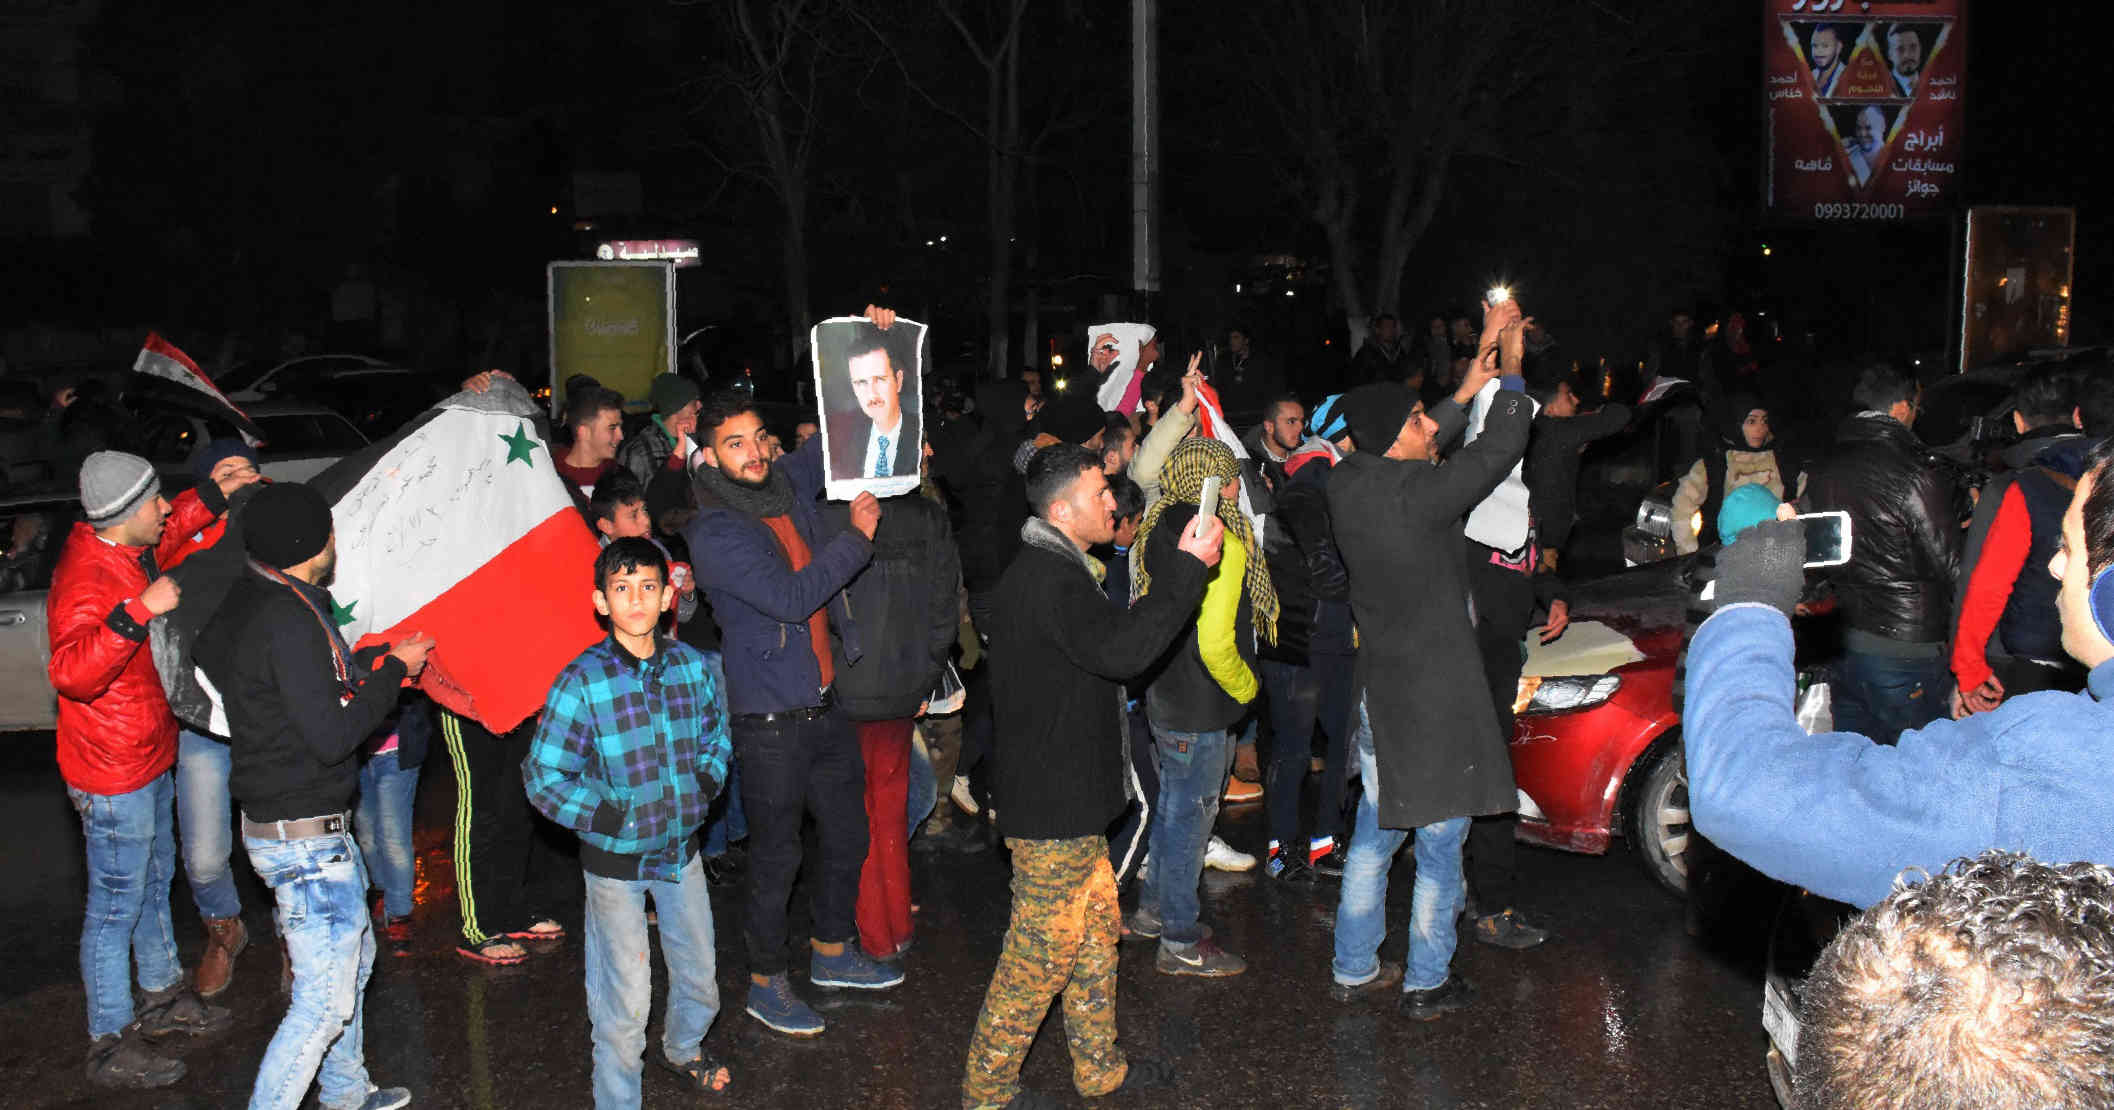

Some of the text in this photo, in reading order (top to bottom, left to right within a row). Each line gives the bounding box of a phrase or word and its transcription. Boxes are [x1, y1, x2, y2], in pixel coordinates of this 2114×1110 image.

[1904, 124, 1944, 152] أبراج
[1892, 158, 1954, 175] مسابقات
[1815, 203, 1904, 219] 0993720001
